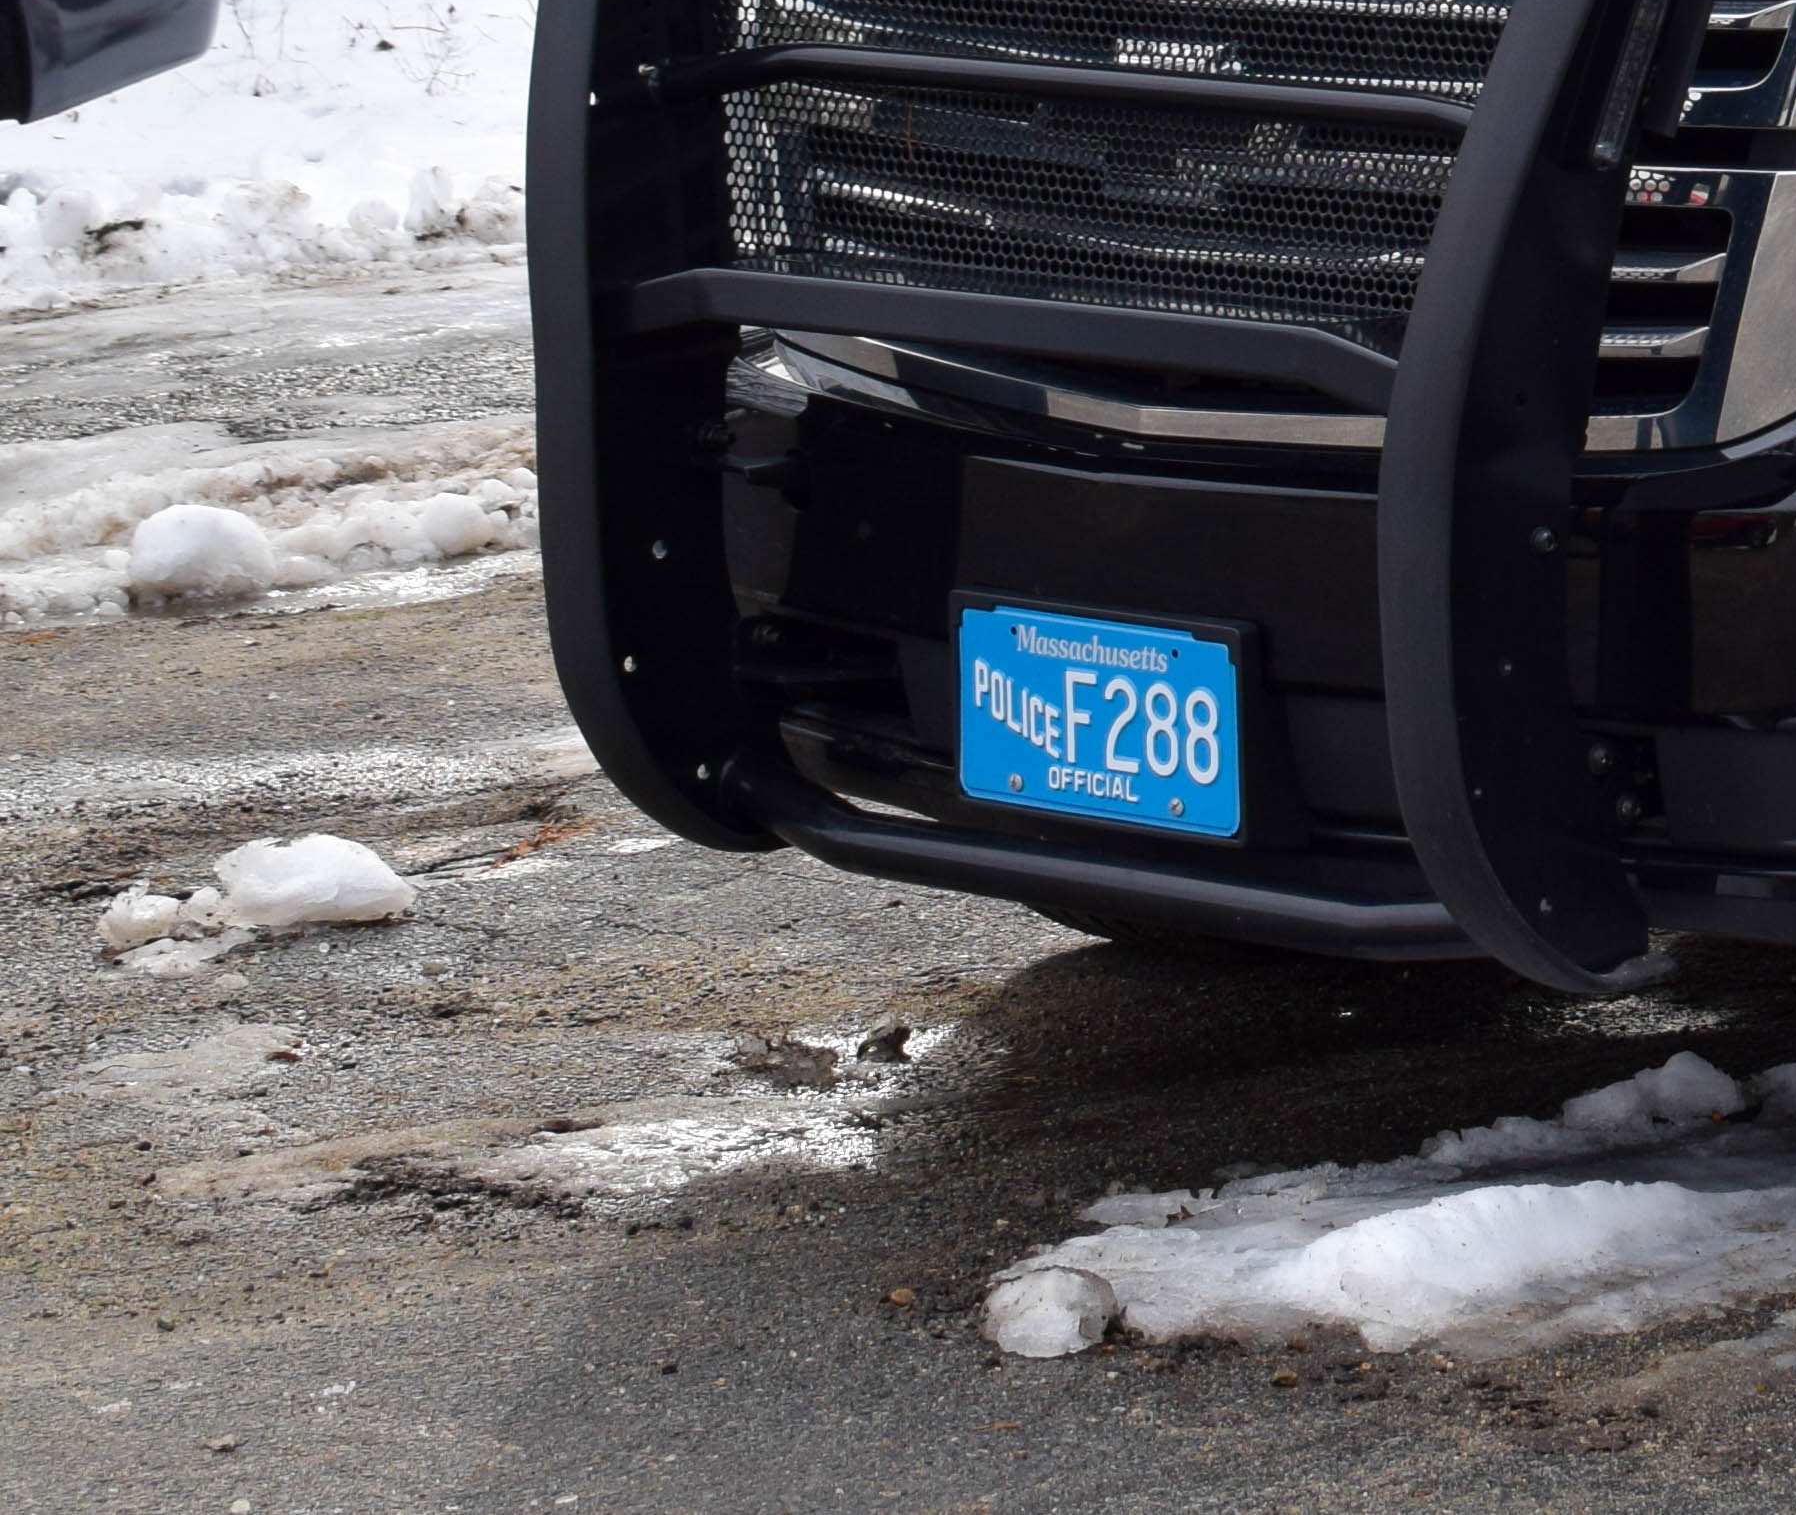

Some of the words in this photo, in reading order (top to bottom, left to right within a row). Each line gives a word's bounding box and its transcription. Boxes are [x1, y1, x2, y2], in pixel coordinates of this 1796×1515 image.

[1016, 624, 1169, 673] Massachusetts
[974, 657, 1061, 760] POLICE
[1063, 668, 1221, 786] F288
[1048, 765, 1140, 803] OFFICIAL
